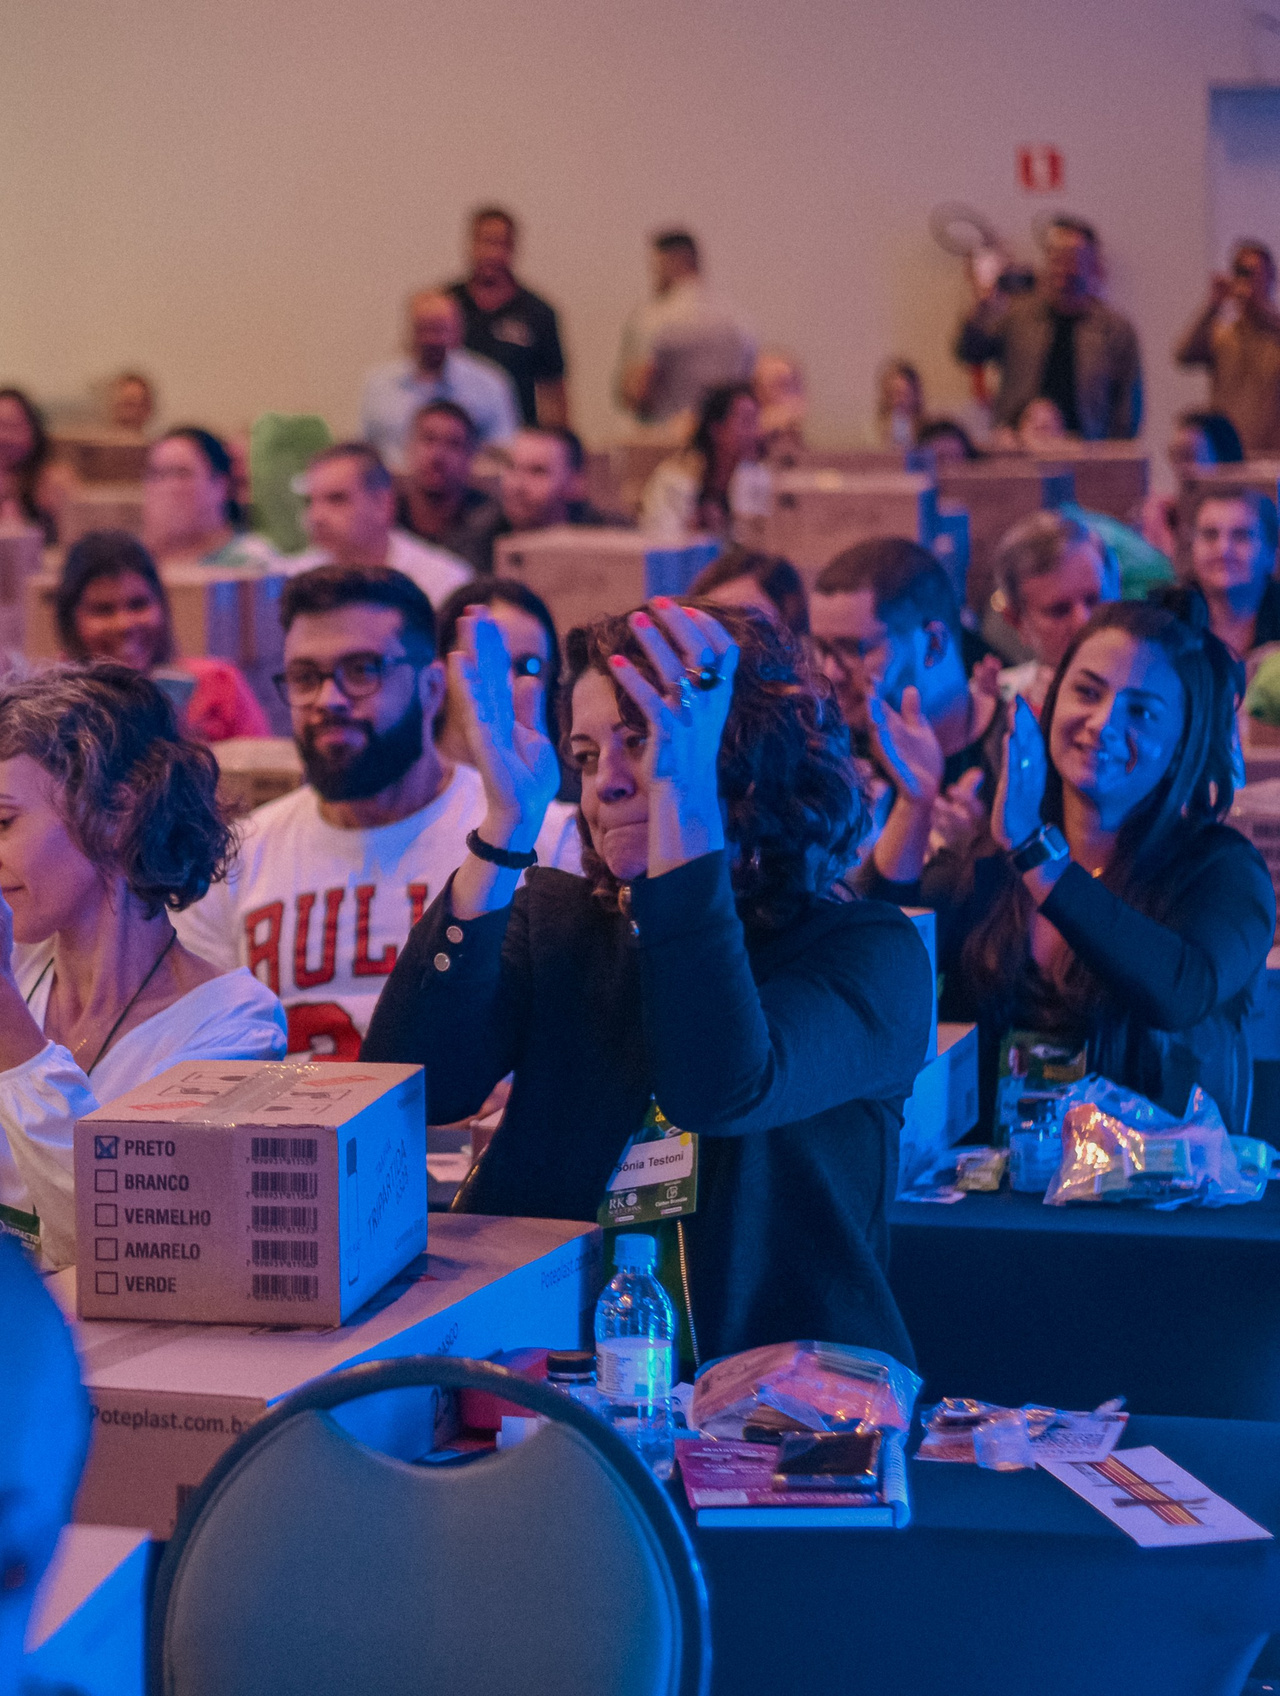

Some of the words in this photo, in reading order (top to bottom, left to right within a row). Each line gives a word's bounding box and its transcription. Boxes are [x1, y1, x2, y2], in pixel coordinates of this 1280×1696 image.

[124, 1139, 175, 1157] PRETO
[648, 1151, 684, 1167] Testoni
[124, 1173, 190, 1191] BRANCO
[124, 1207, 211, 1227] VERMELHO
[124, 1241, 201, 1260] AMARELO
[124, 1275, 177, 1293] VERDE
